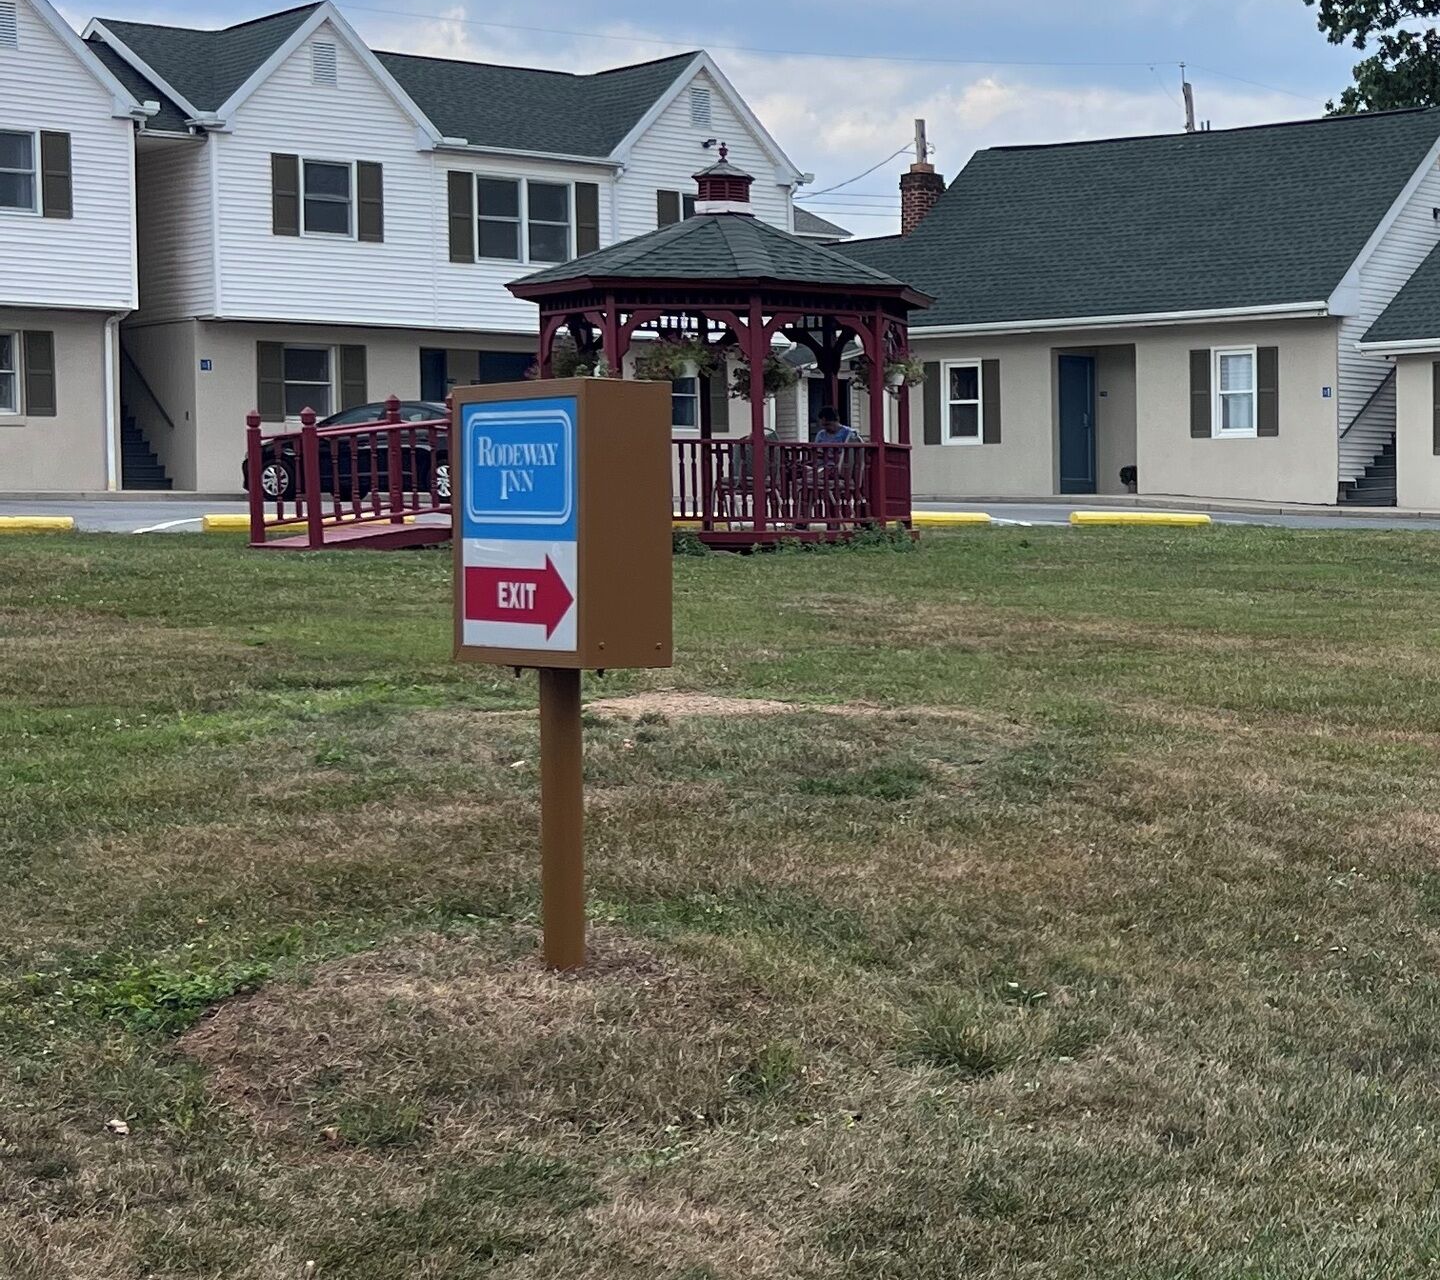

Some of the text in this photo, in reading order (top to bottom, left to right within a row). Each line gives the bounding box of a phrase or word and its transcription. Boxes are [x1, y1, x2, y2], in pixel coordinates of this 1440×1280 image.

[477, 435, 559, 467] RODEWAY
[499, 469, 535, 500] INN
[497, 581, 537, 610] EXIT
